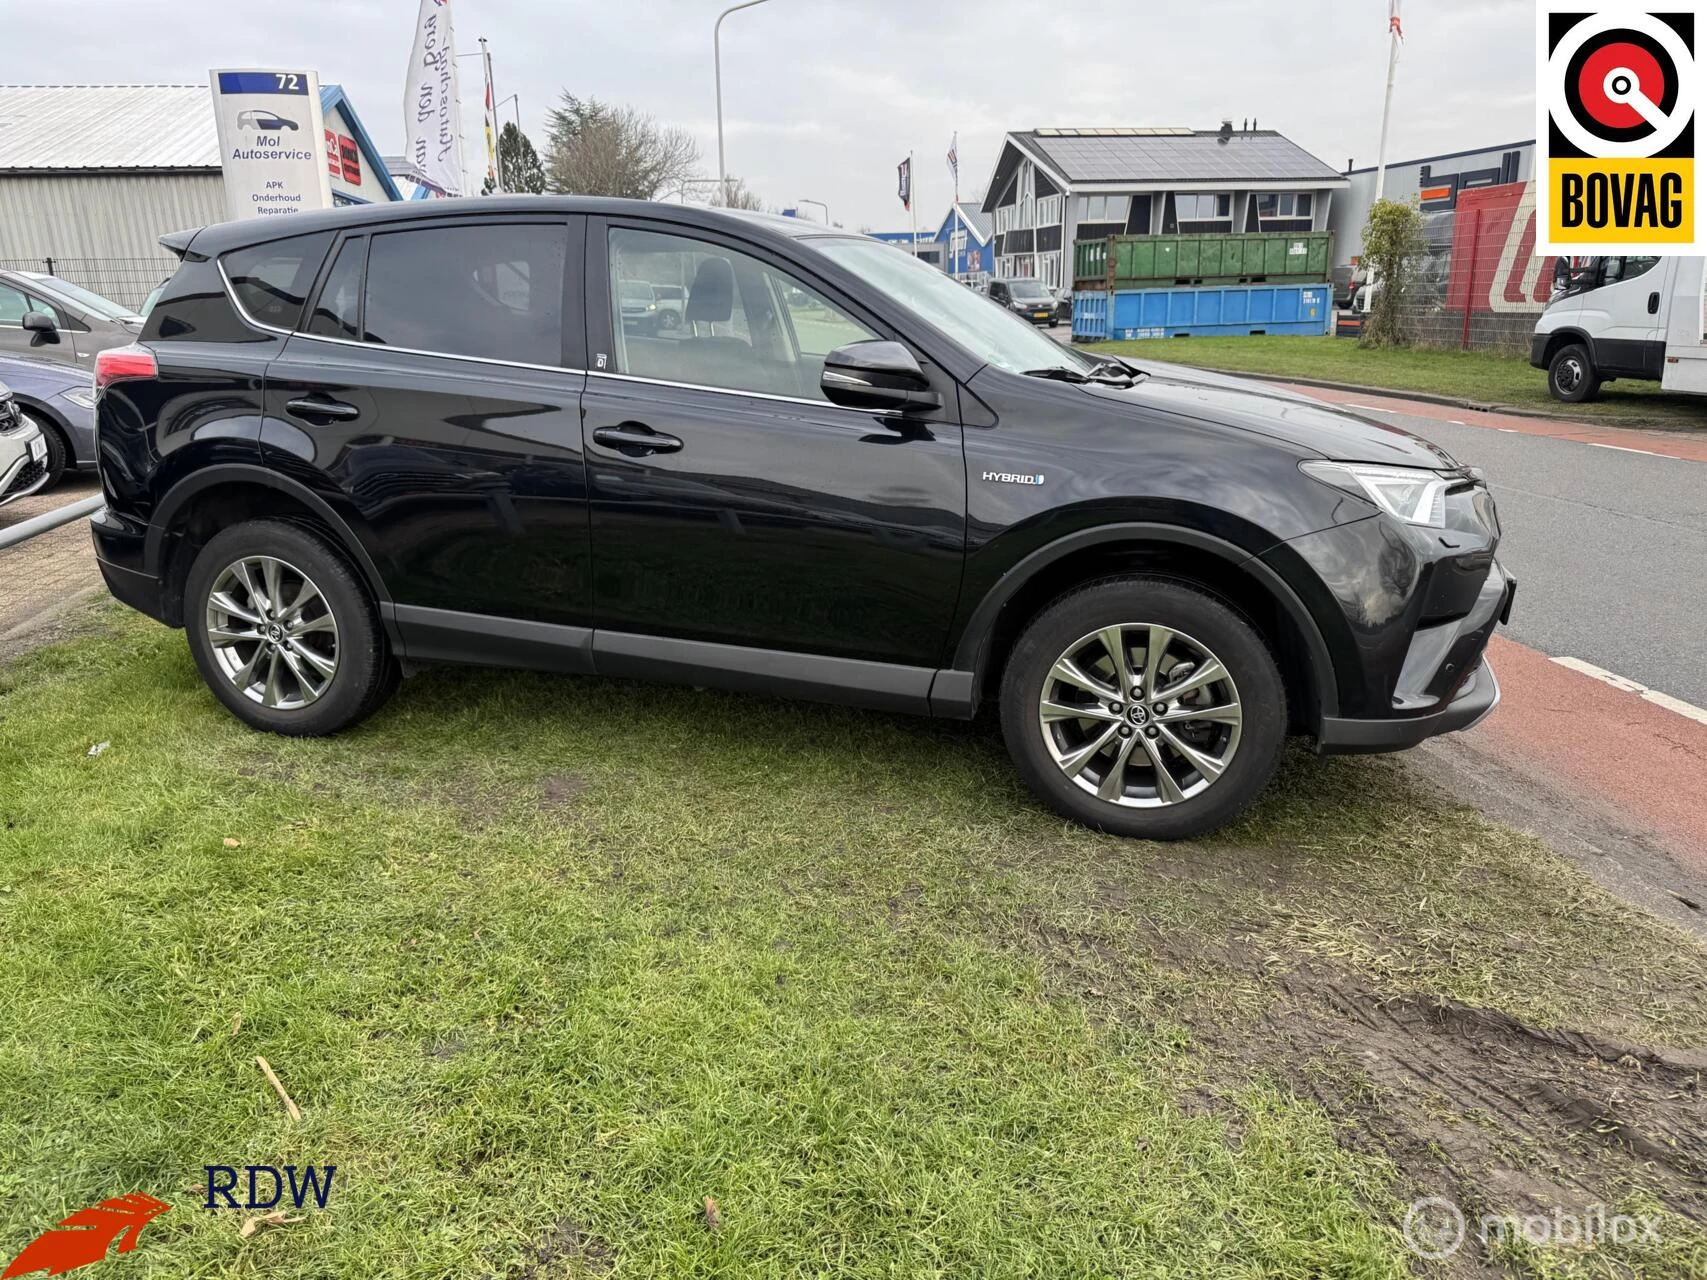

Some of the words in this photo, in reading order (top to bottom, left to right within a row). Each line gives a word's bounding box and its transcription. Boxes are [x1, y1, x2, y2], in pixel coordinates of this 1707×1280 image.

[275, 74, 299, 90] 72
[256, 136, 280, 147] Mol
[232, 149, 312, 160] Autoservice
[266, 181, 284, 189] APK
[252, 193, 301, 202] Onderhoud
[257, 206, 299, 215] Reparatie
[982, 471, 1034, 485] HYBRID
